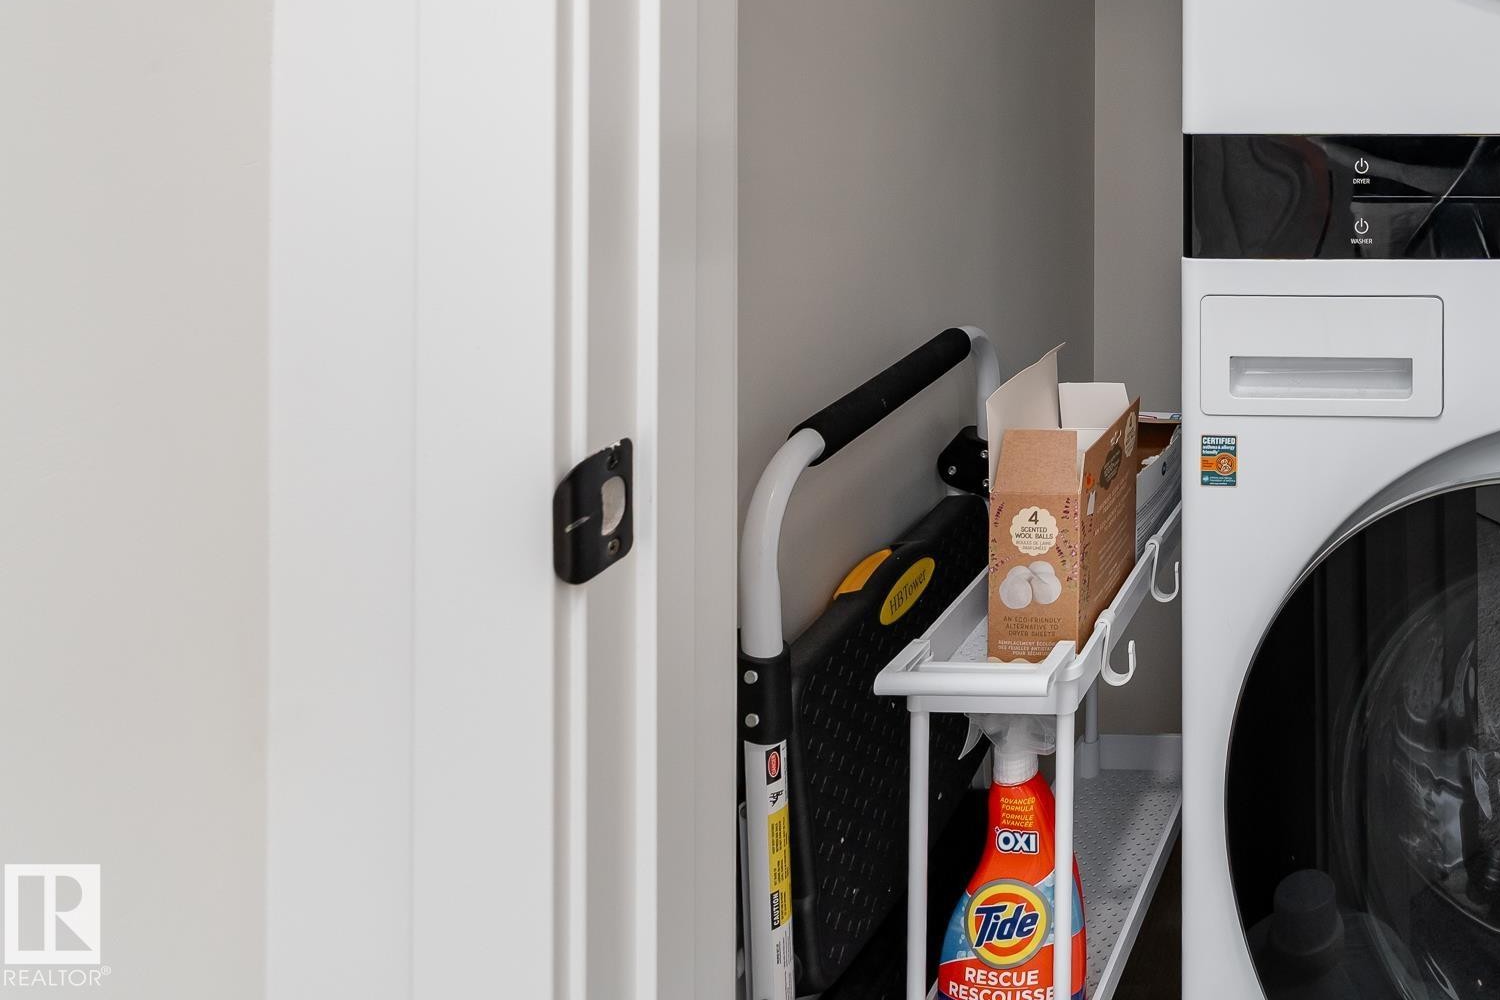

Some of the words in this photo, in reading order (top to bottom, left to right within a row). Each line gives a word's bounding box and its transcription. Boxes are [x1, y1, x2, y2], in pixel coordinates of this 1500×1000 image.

[1202, 437, 1236, 445] CERTIFIED
[1028, 511, 1039, 525] 4
[889, 569, 926, 615] HBTower
[1000, 797, 1036, 805] ADVANCED
[1002, 804, 1034, 812] FORMULA
[1002, 812, 1035, 820] FORMULE
[997, 830, 1038, 853] OXI
[973, 903, 1040, 949] Tide
[965, 967, 1039, 987] RESCUE
[949, 981, 1054, 1000] RESCOUSSE
